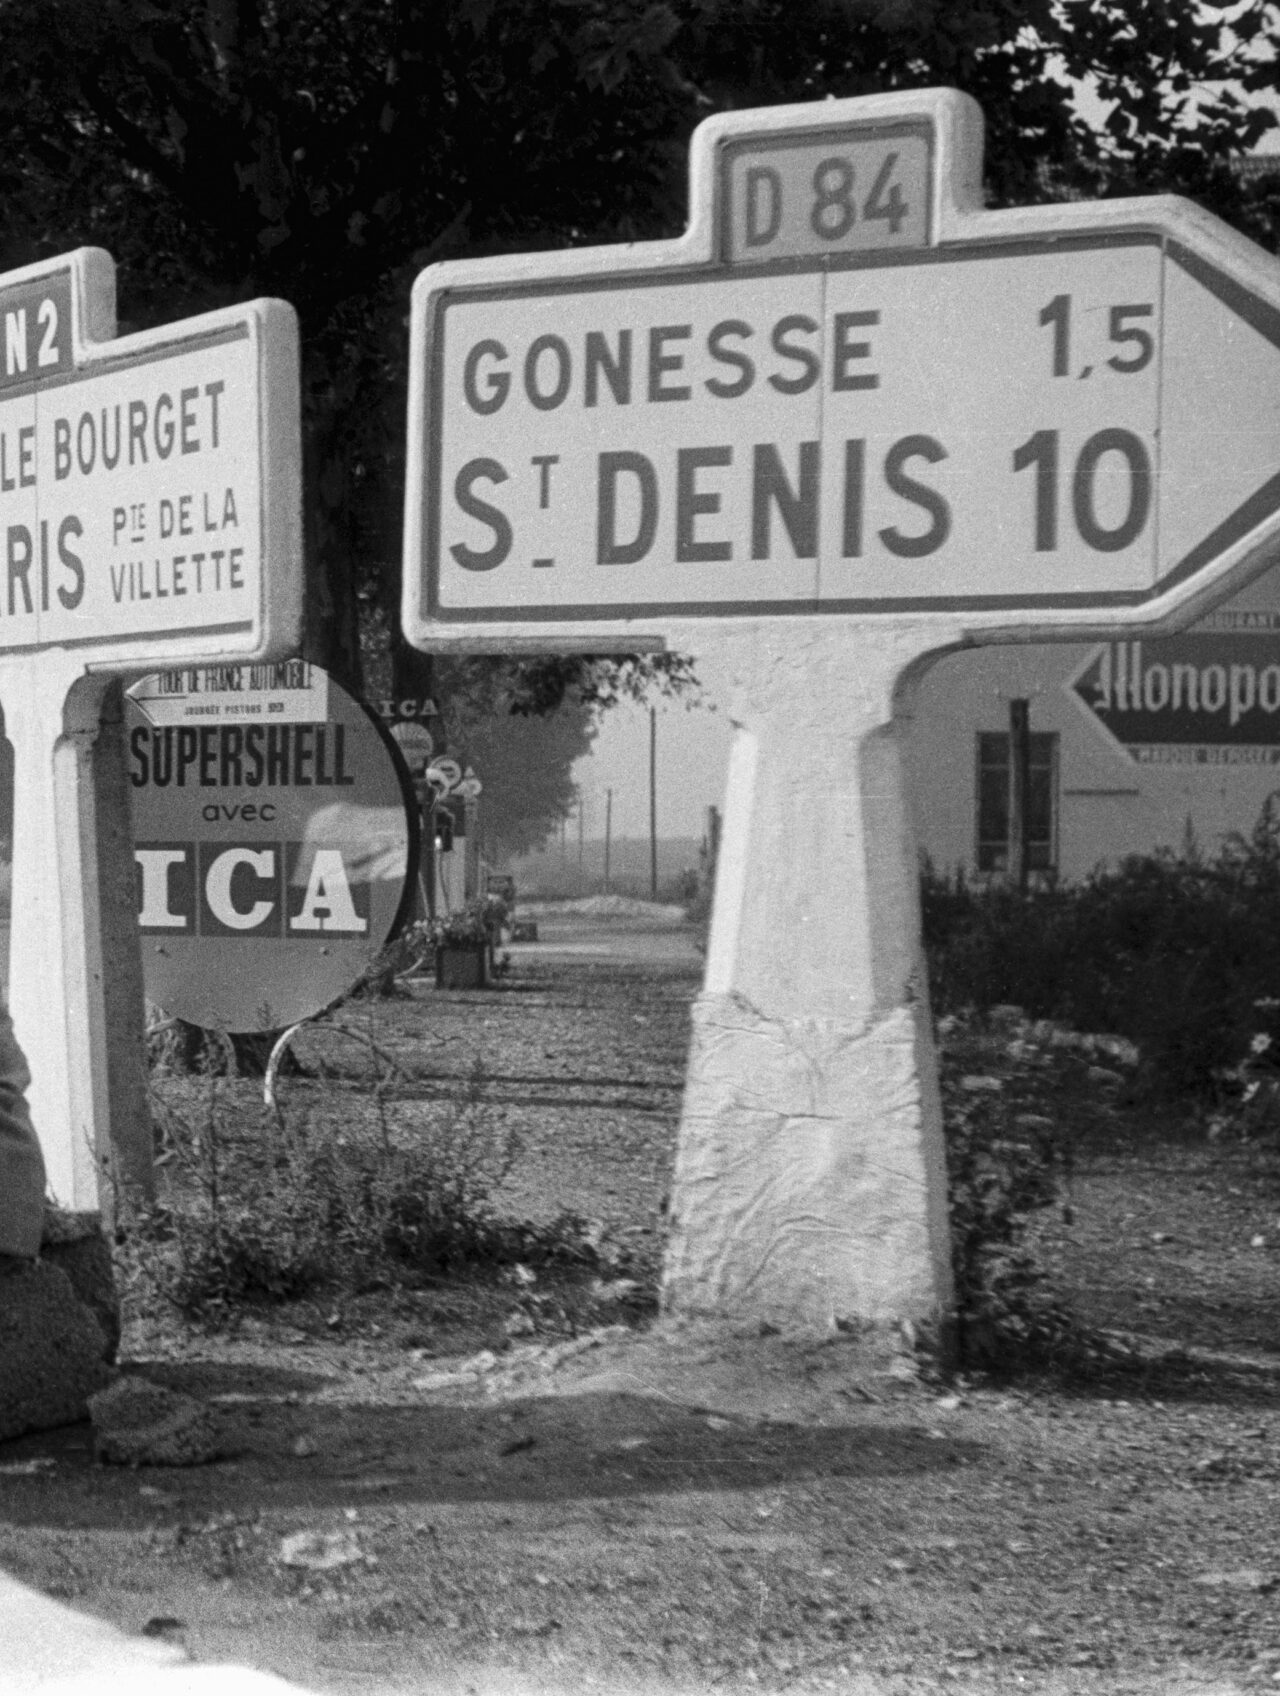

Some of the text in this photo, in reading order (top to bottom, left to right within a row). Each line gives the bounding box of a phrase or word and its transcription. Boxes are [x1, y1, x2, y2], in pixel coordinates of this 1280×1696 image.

[745, 151, 909, 249] D 84
[462, 293, 1156, 416] GONESSE 1,5
[1, 425, 37, 493] LE
[54, 379, 226, 481] BOURGET
[112, 487, 239, 547] PTE DE LA
[596, 434, 951, 567] DENIS
[1011, 426, 1153, 554] 10
[109, 546, 245, 604] VILLETTE
[159, 661, 312, 695] TOUR DE FRANCE AUTOMOBILE
[225, 703, 262, 715] PISTONS
[379, 699, 439, 718] ICA
[129, 723, 355, 788] SUPERSHELL
[201, 803, 277, 822] avec
[134, 847, 368, 932] ICA
